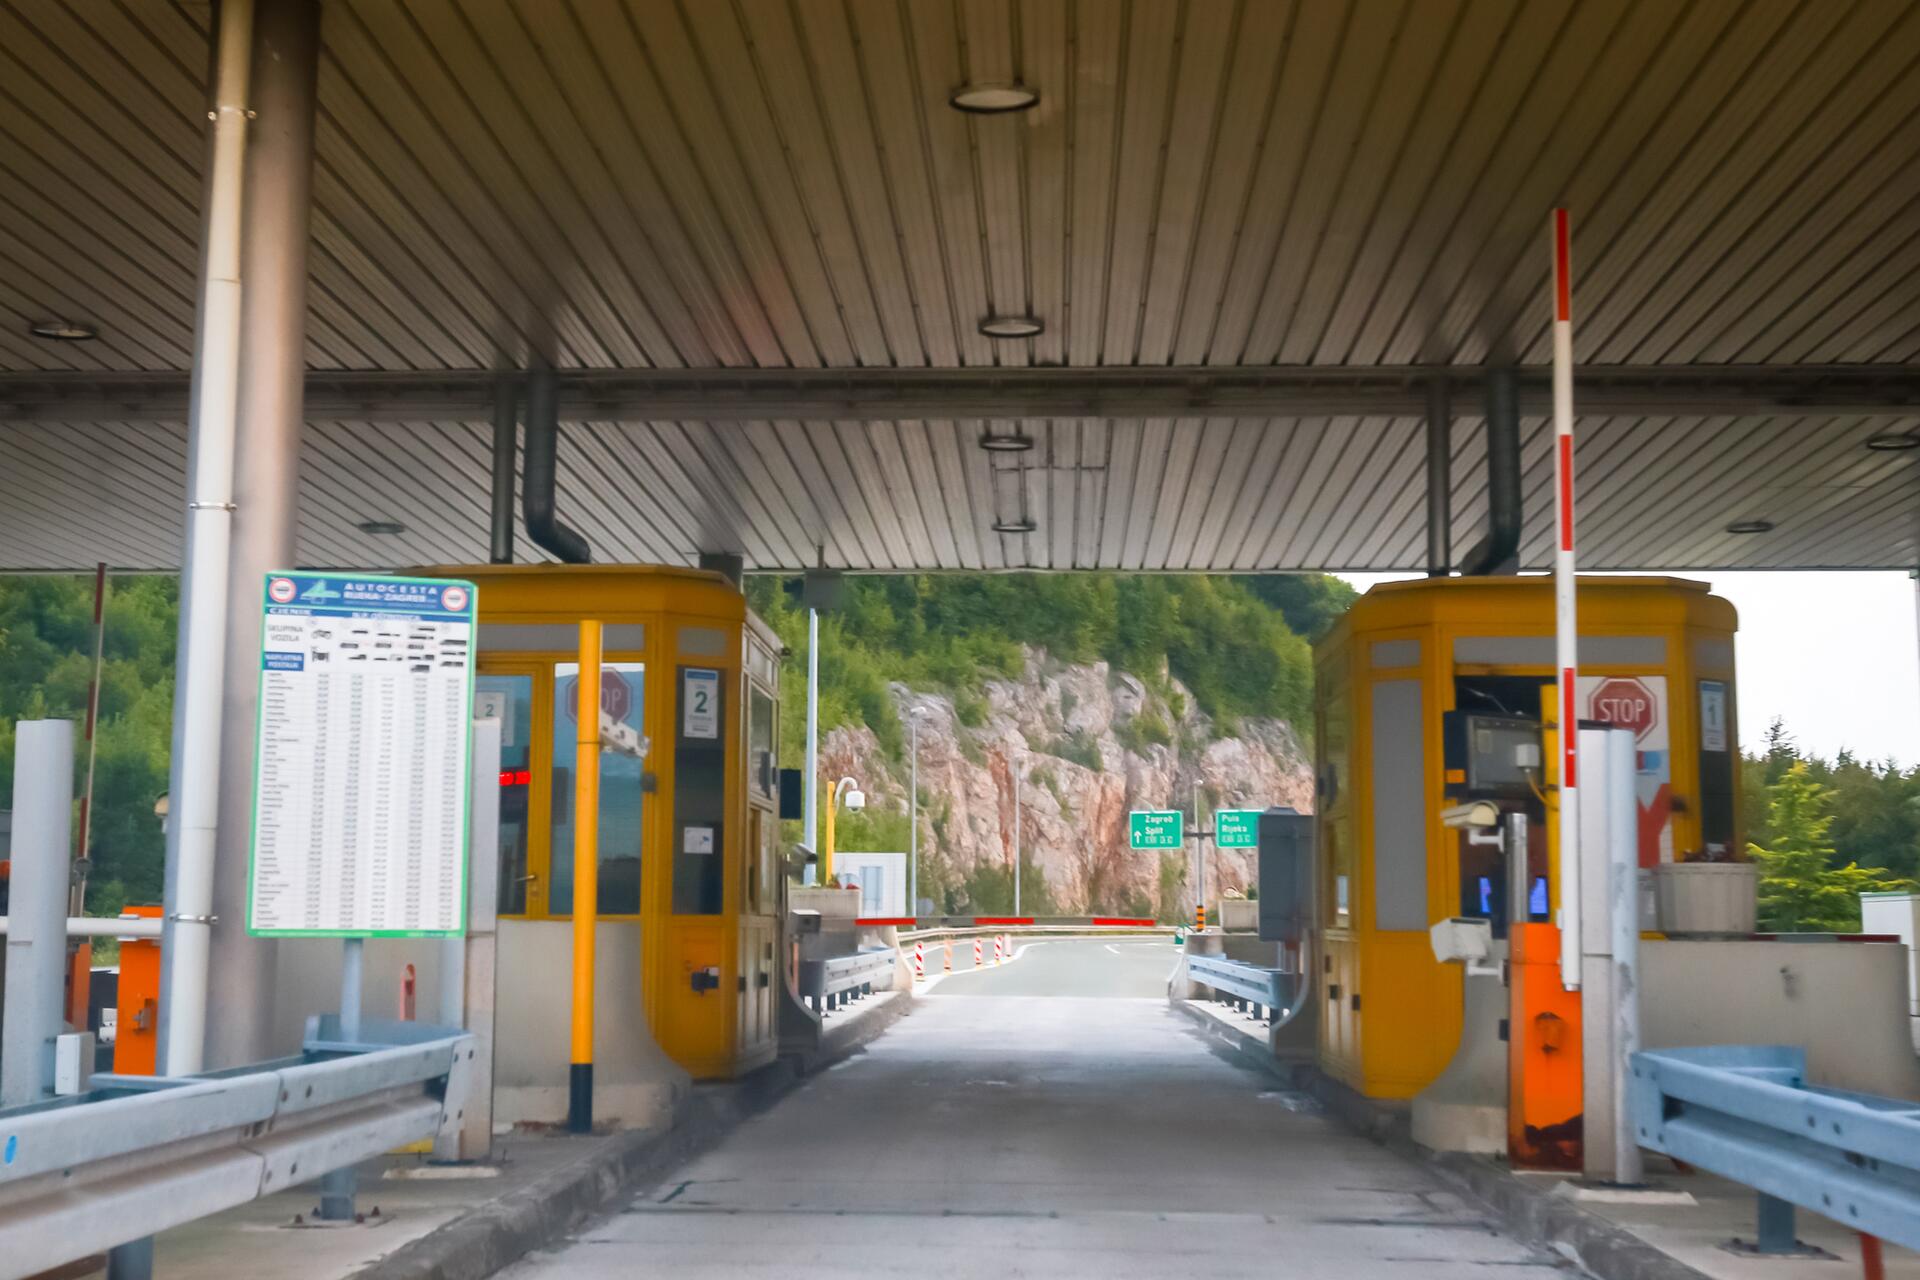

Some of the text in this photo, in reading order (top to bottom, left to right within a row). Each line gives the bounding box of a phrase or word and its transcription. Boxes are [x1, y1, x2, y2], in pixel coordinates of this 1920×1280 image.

[344, 583, 438, 594] AUTOCESTA
[694, 691, 708, 713] 2
[485, 703, 494, 717] 2
[1600, 699, 1645, 722] STOP
[1708, 704, 1716, 725] 1
[1145, 815, 1173, 825] Zagreb
[1221, 814, 1240, 823] Pula
[1145, 826, 1163, 836] Split
[1221, 824, 1248, 834] Rijeka
